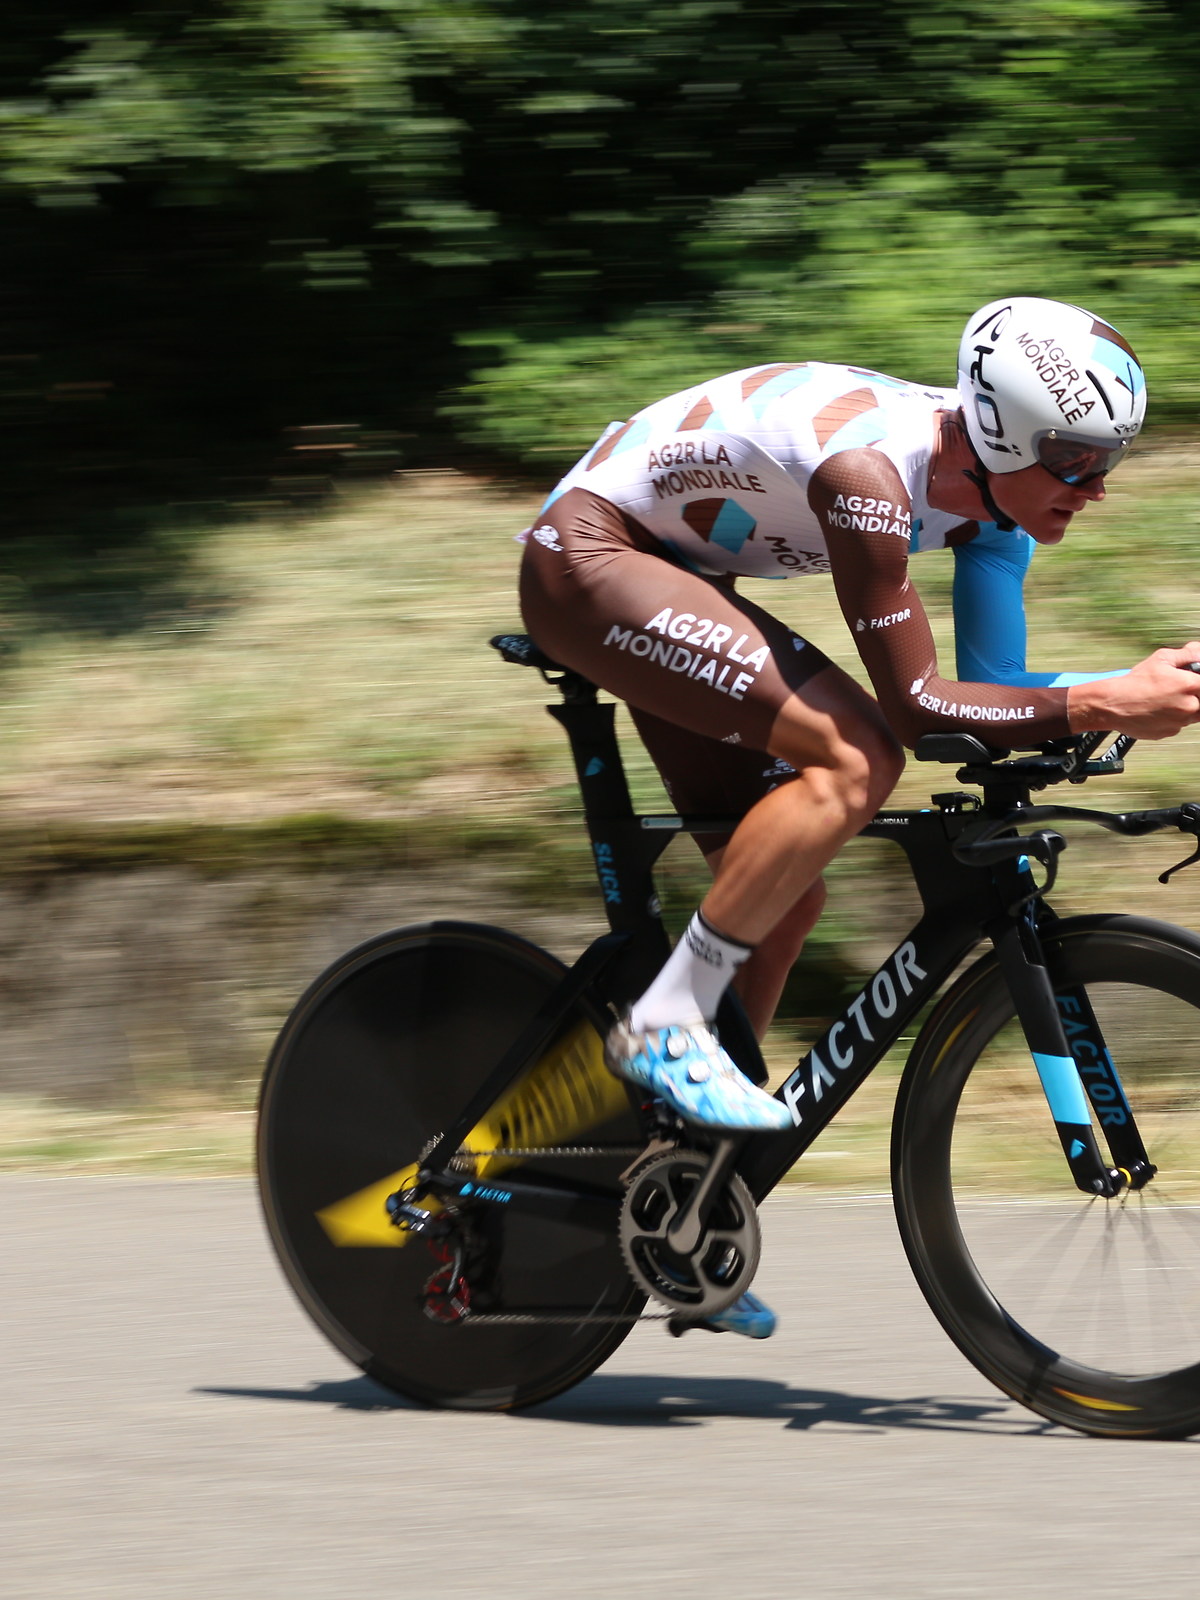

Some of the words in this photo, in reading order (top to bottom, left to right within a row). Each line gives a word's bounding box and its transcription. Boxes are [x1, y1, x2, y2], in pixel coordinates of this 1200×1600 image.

[1015, 332, 1084, 426] MONDIALE
[1039, 338, 1080, 386] AG2R
[1074, 386, 1096, 416] LA
[648, 441, 697, 473] AG2R
[701, 441, 733, 467] LA
[652, 469, 767, 500] MONDIALE
[827, 509, 912, 541] MONDIALE
[833, 494, 894, 517] AG2R
[895, 504, 911, 526] LA
[644, 607, 733, 653] AG2R
[726, 634, 771, 673] LA
[870, 608, 911, 630] FACTOR
[603, 625, 755, 701] MONDIALE
[917, 693, 941, 713] G2R
[940, 700, 958, 717] LA
[958, 704, 1035, 721] MONDIALE
[594, 842, 622, 904] SLICK
[783, 940, 928, 1128] FACTOR
[1055, 996, 1127, 1126] FACTOR
[474, 1186, 513, 1204] FACTOR
